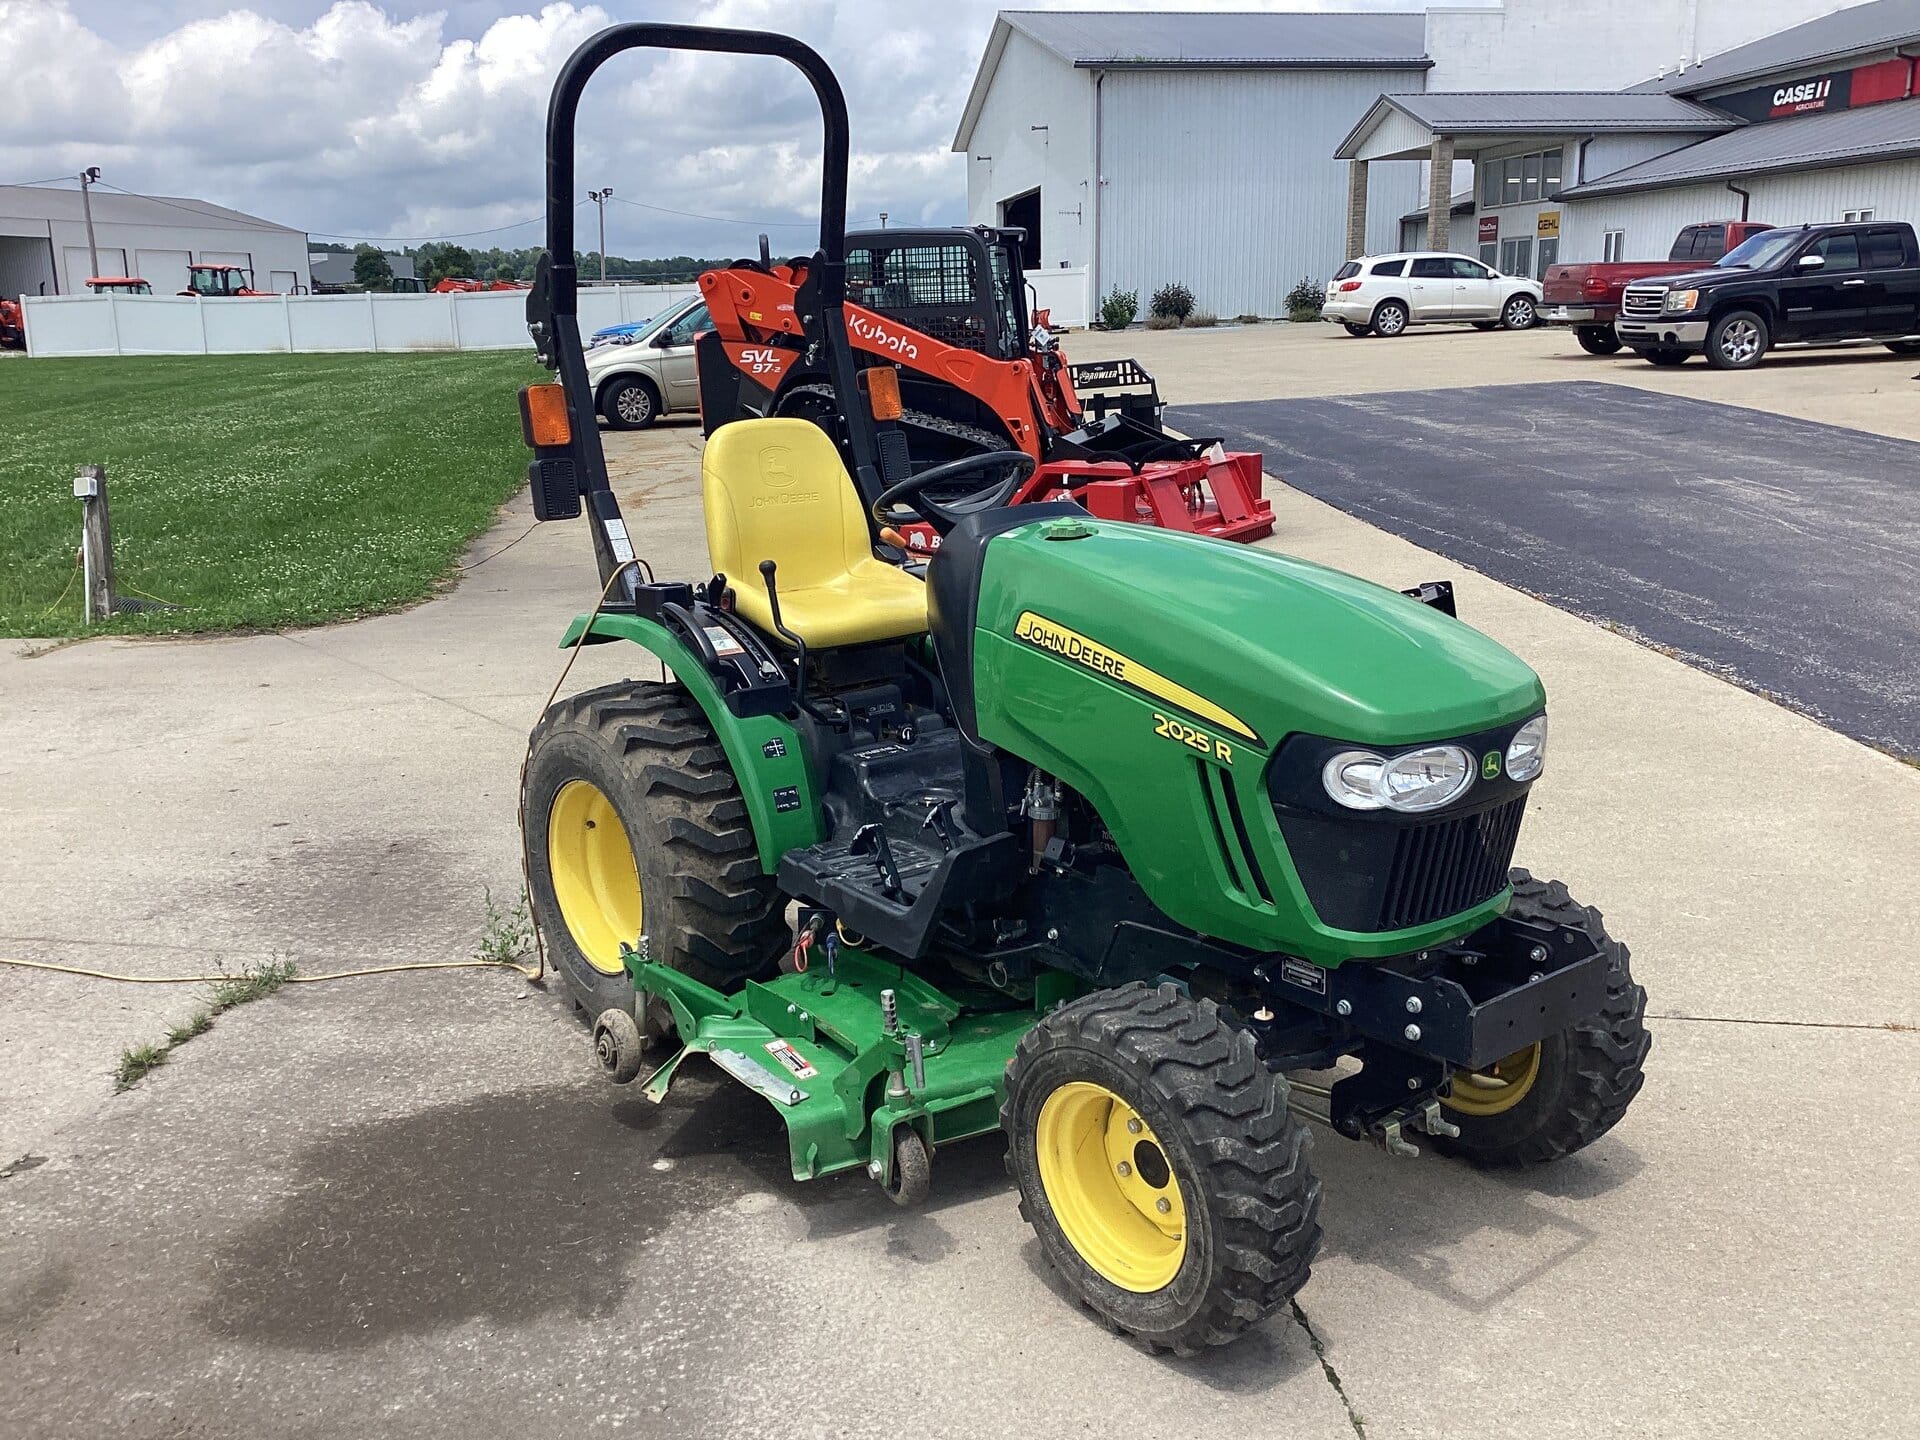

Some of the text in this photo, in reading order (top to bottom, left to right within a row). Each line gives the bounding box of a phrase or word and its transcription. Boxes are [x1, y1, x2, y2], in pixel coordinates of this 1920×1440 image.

[1795, 100, 1825, 111] AGRICULTURE
[1538, 219, 1559, 231] GEHL
[849, 313, 918, 360] Kubota
[740, 350, 781, 364] SVL
[747, 491, 820, 508] JOHN DEERE
[1022, 621, 1126, 679] JOHN DEERE
[1153, 712, 1234, 765] 2025 R
